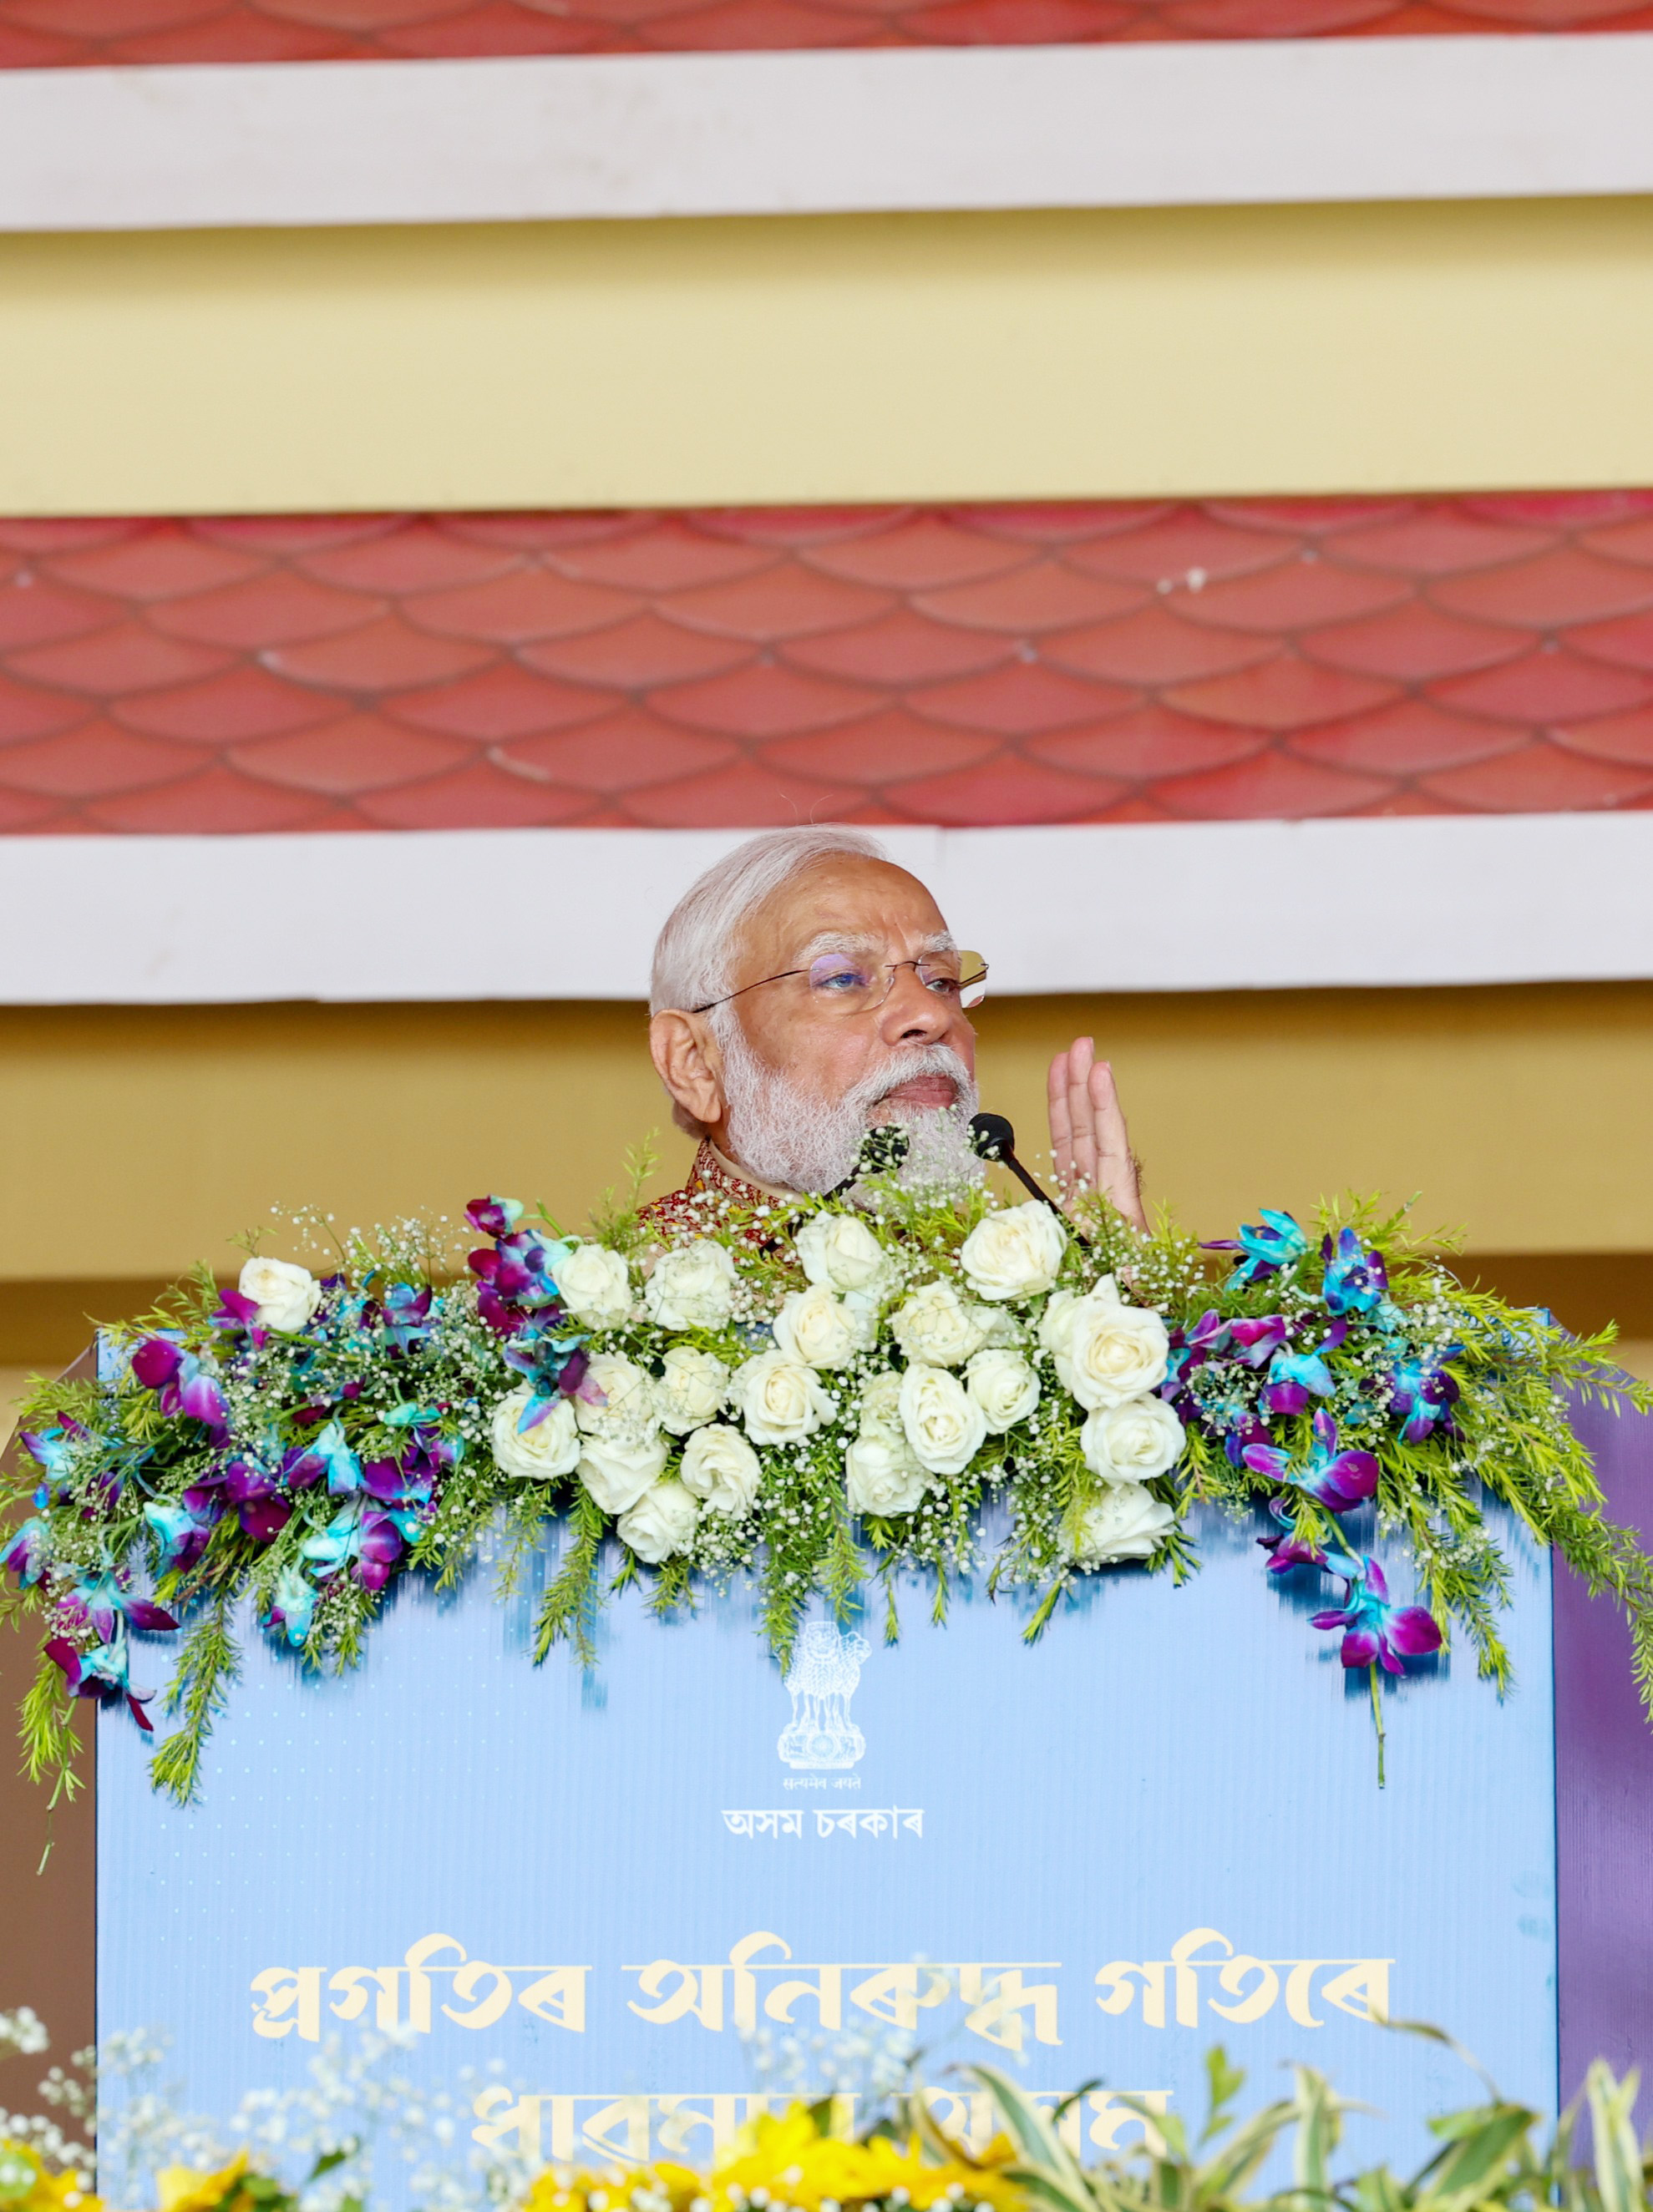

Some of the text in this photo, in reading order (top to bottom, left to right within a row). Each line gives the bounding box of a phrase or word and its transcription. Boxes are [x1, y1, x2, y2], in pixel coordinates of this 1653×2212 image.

[783, 1772, 862, 1790] सत्यमेव जयते
[721, 1805, 925, 1839] অসম চৰকাৰ
[250, 1927, 1396, 2051] প্ৰগতিৰ অনিৰুদ্ধ গতিৰে
